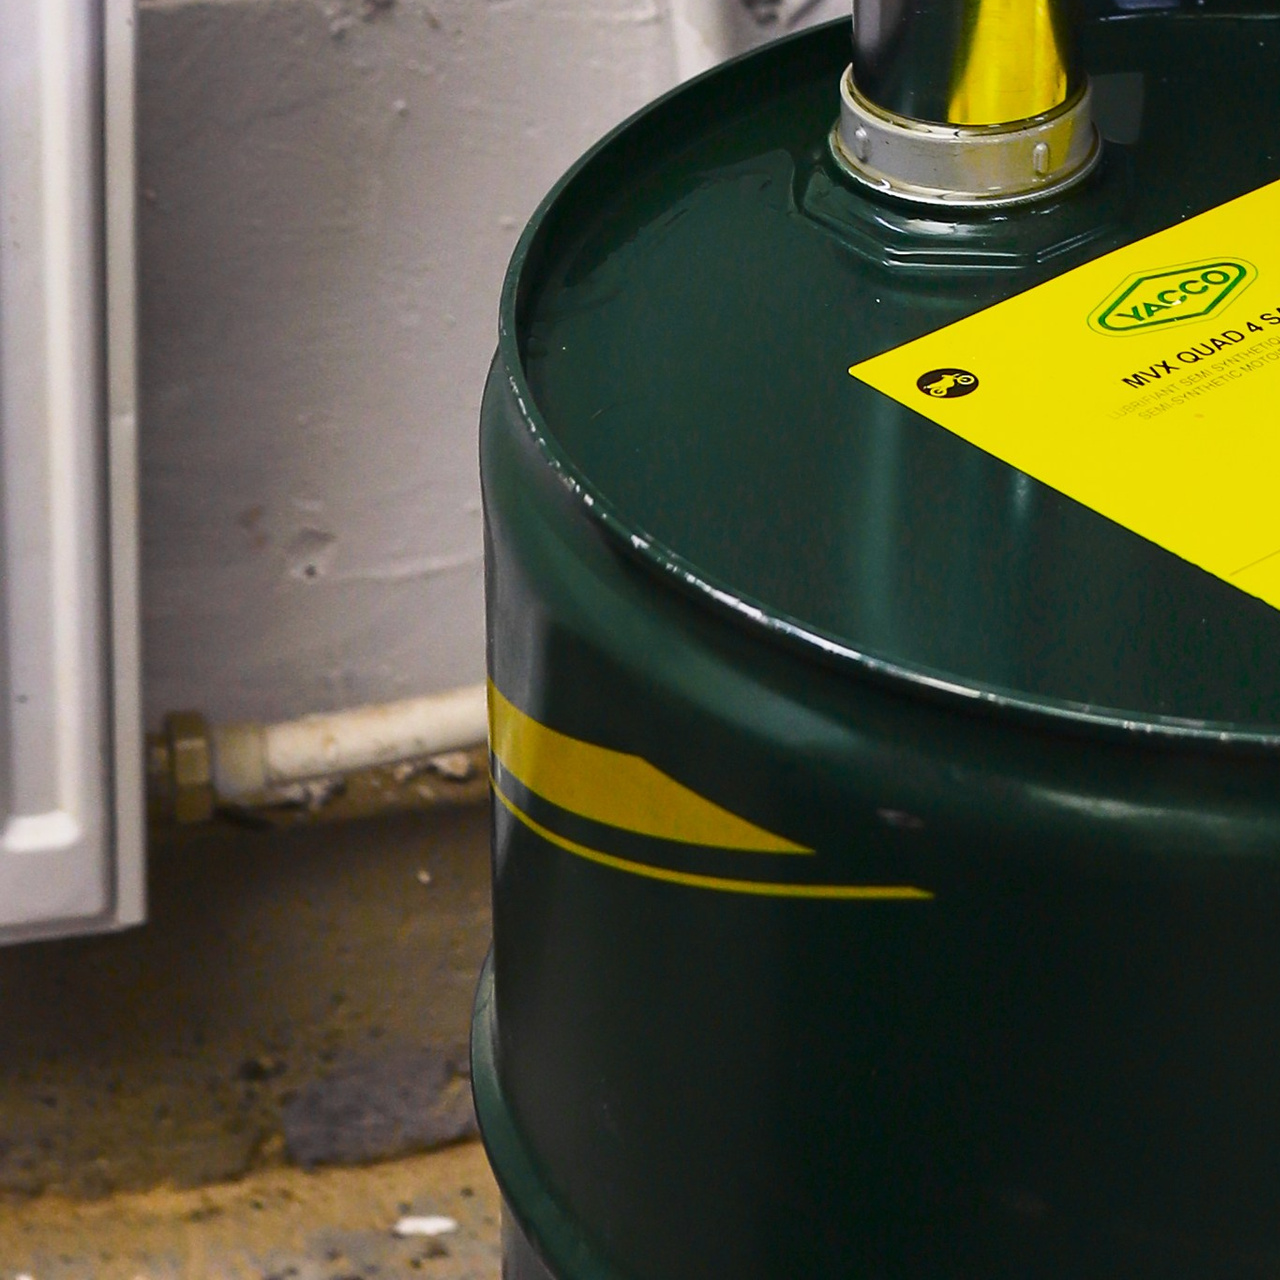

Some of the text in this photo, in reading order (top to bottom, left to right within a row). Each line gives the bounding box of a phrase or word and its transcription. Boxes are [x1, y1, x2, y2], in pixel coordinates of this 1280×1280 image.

[1116, 269, 1230, 321] YACCO
[1121, 359, 1179, 388] MVX
[1176, 329, 1245, 363] QUAD
[1246, 321, 1264, 332] 4
[1106, 382, 1181, 420] LUBRIFIANT
[1179, 368, 1213, 386] SEMI
